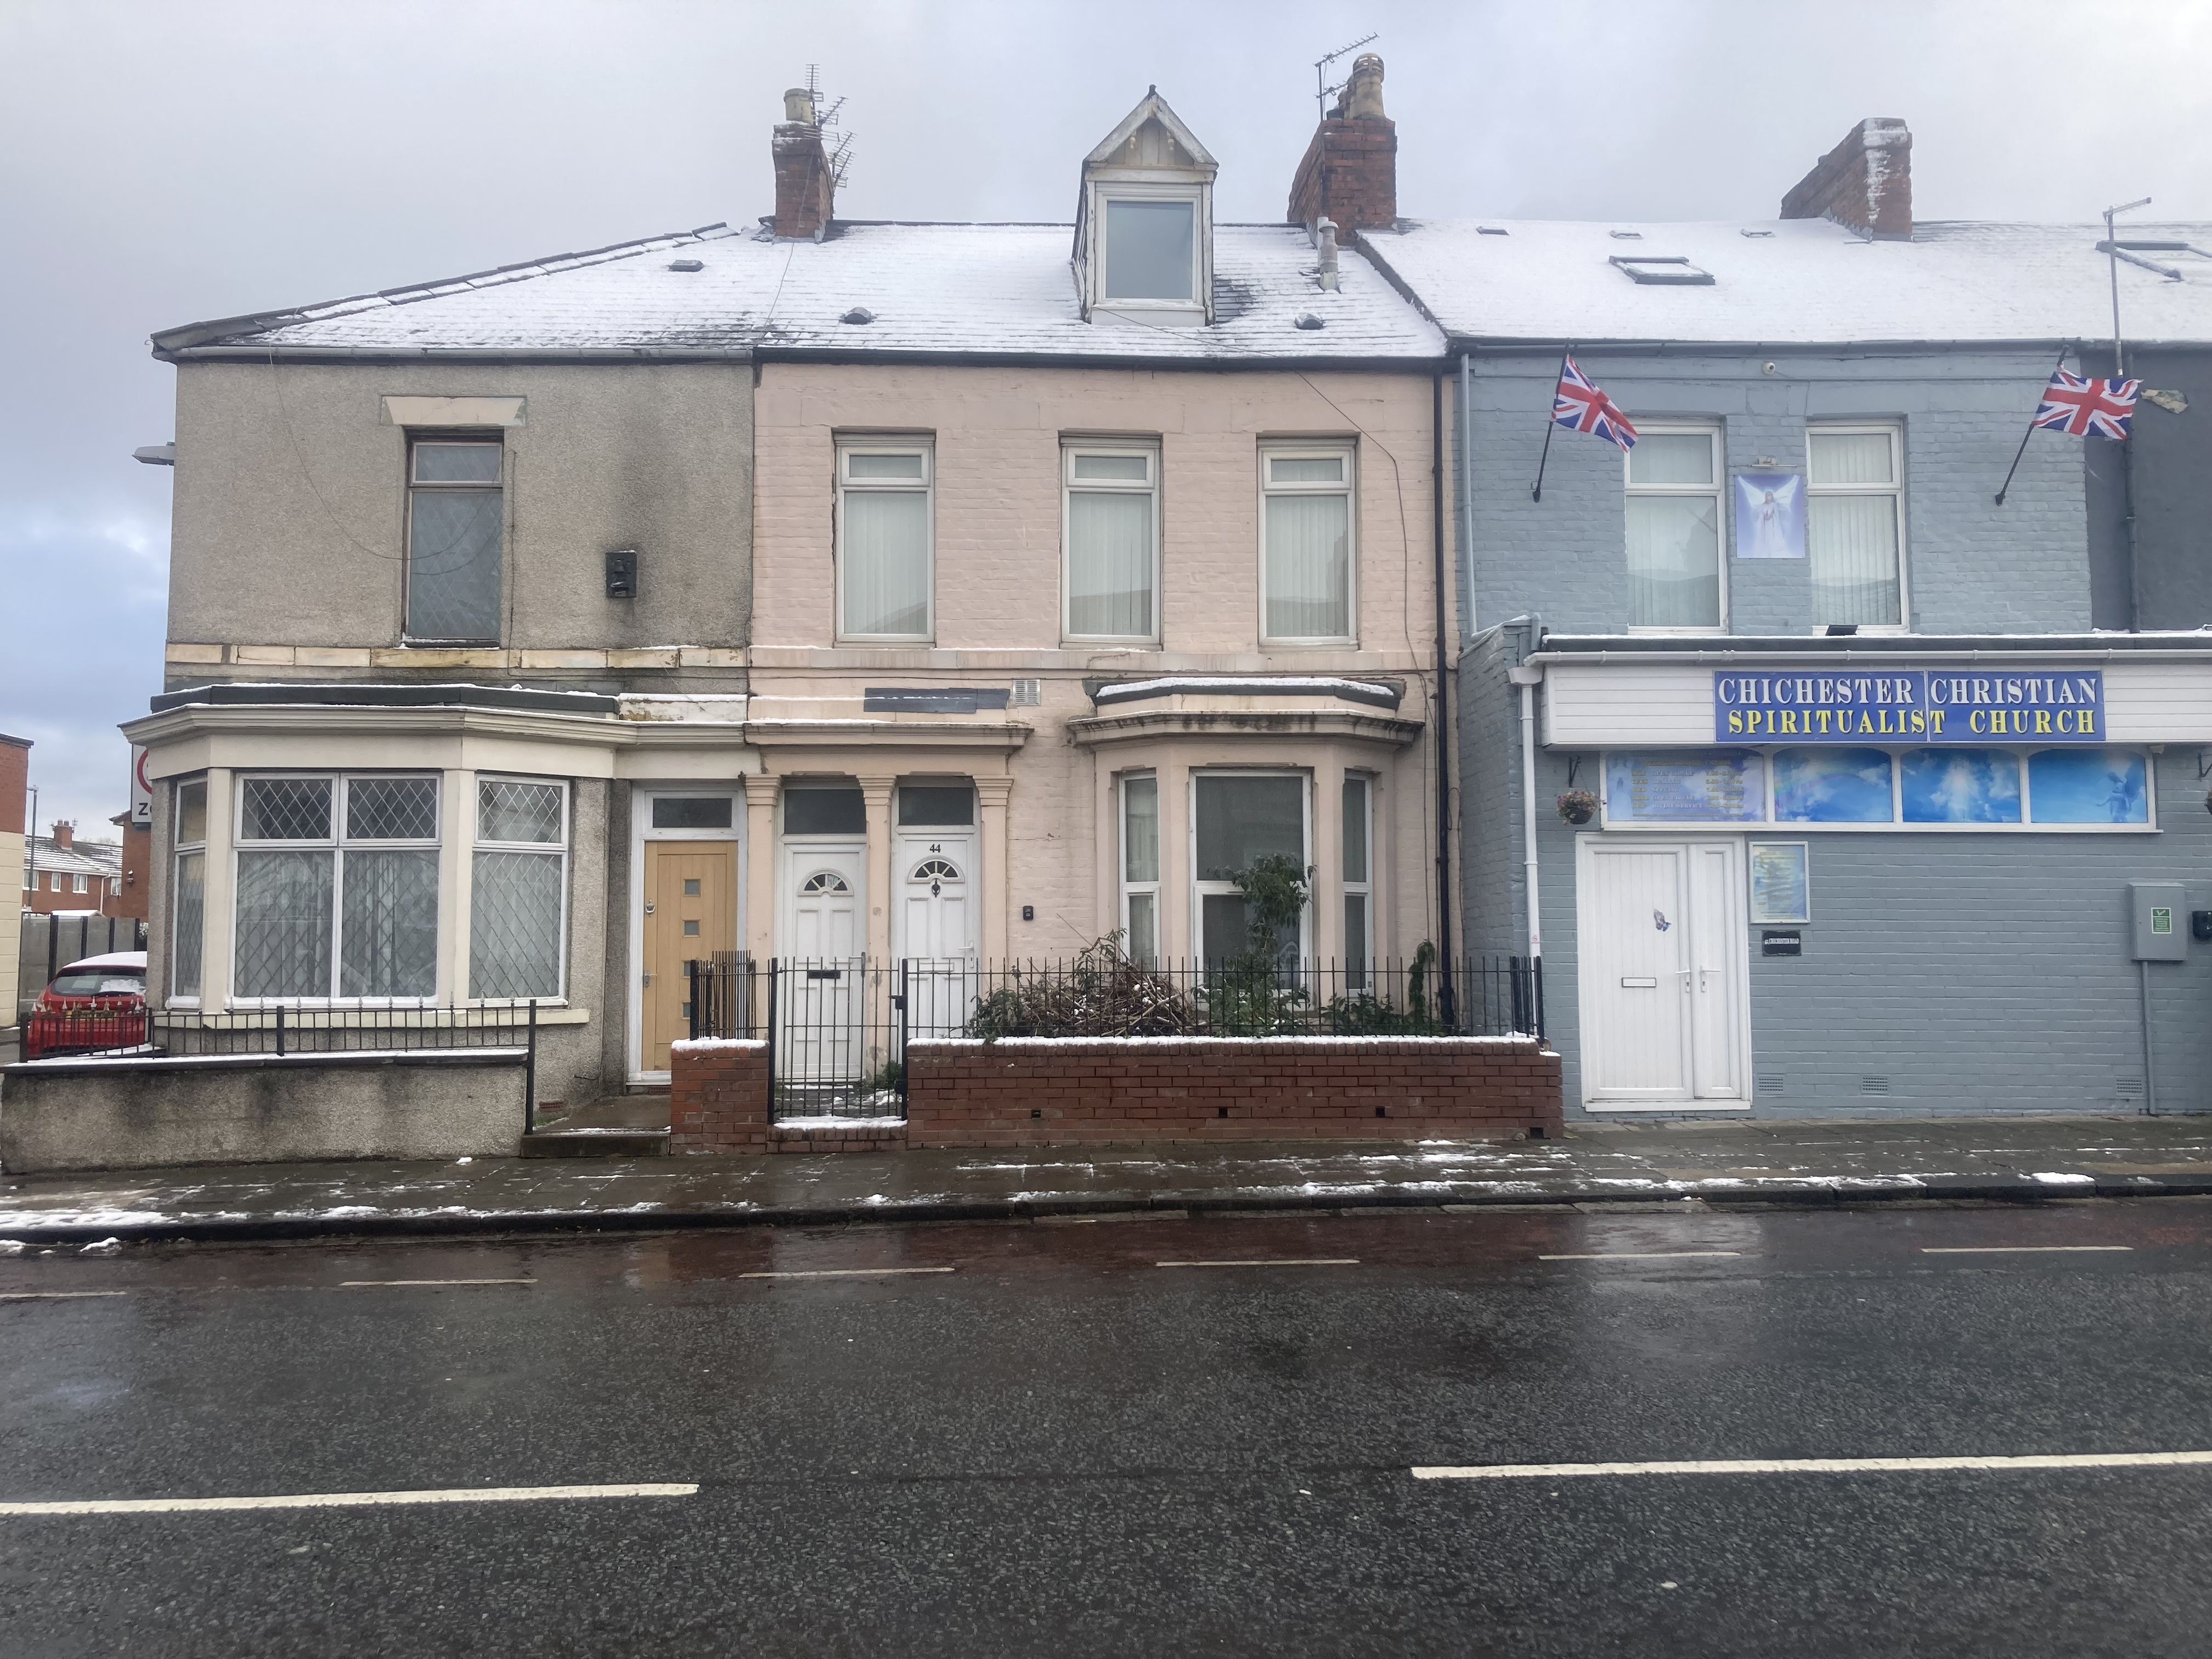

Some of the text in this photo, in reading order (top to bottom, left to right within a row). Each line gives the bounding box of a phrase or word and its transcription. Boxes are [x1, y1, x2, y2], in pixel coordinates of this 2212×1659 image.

[1718, 678, 2097, 704] CHICHESTER CHRISTIAN
[1728, 709, 2096, 734] SPIRITUALIST CHURCH
[929, 844, 941, 853] 44
